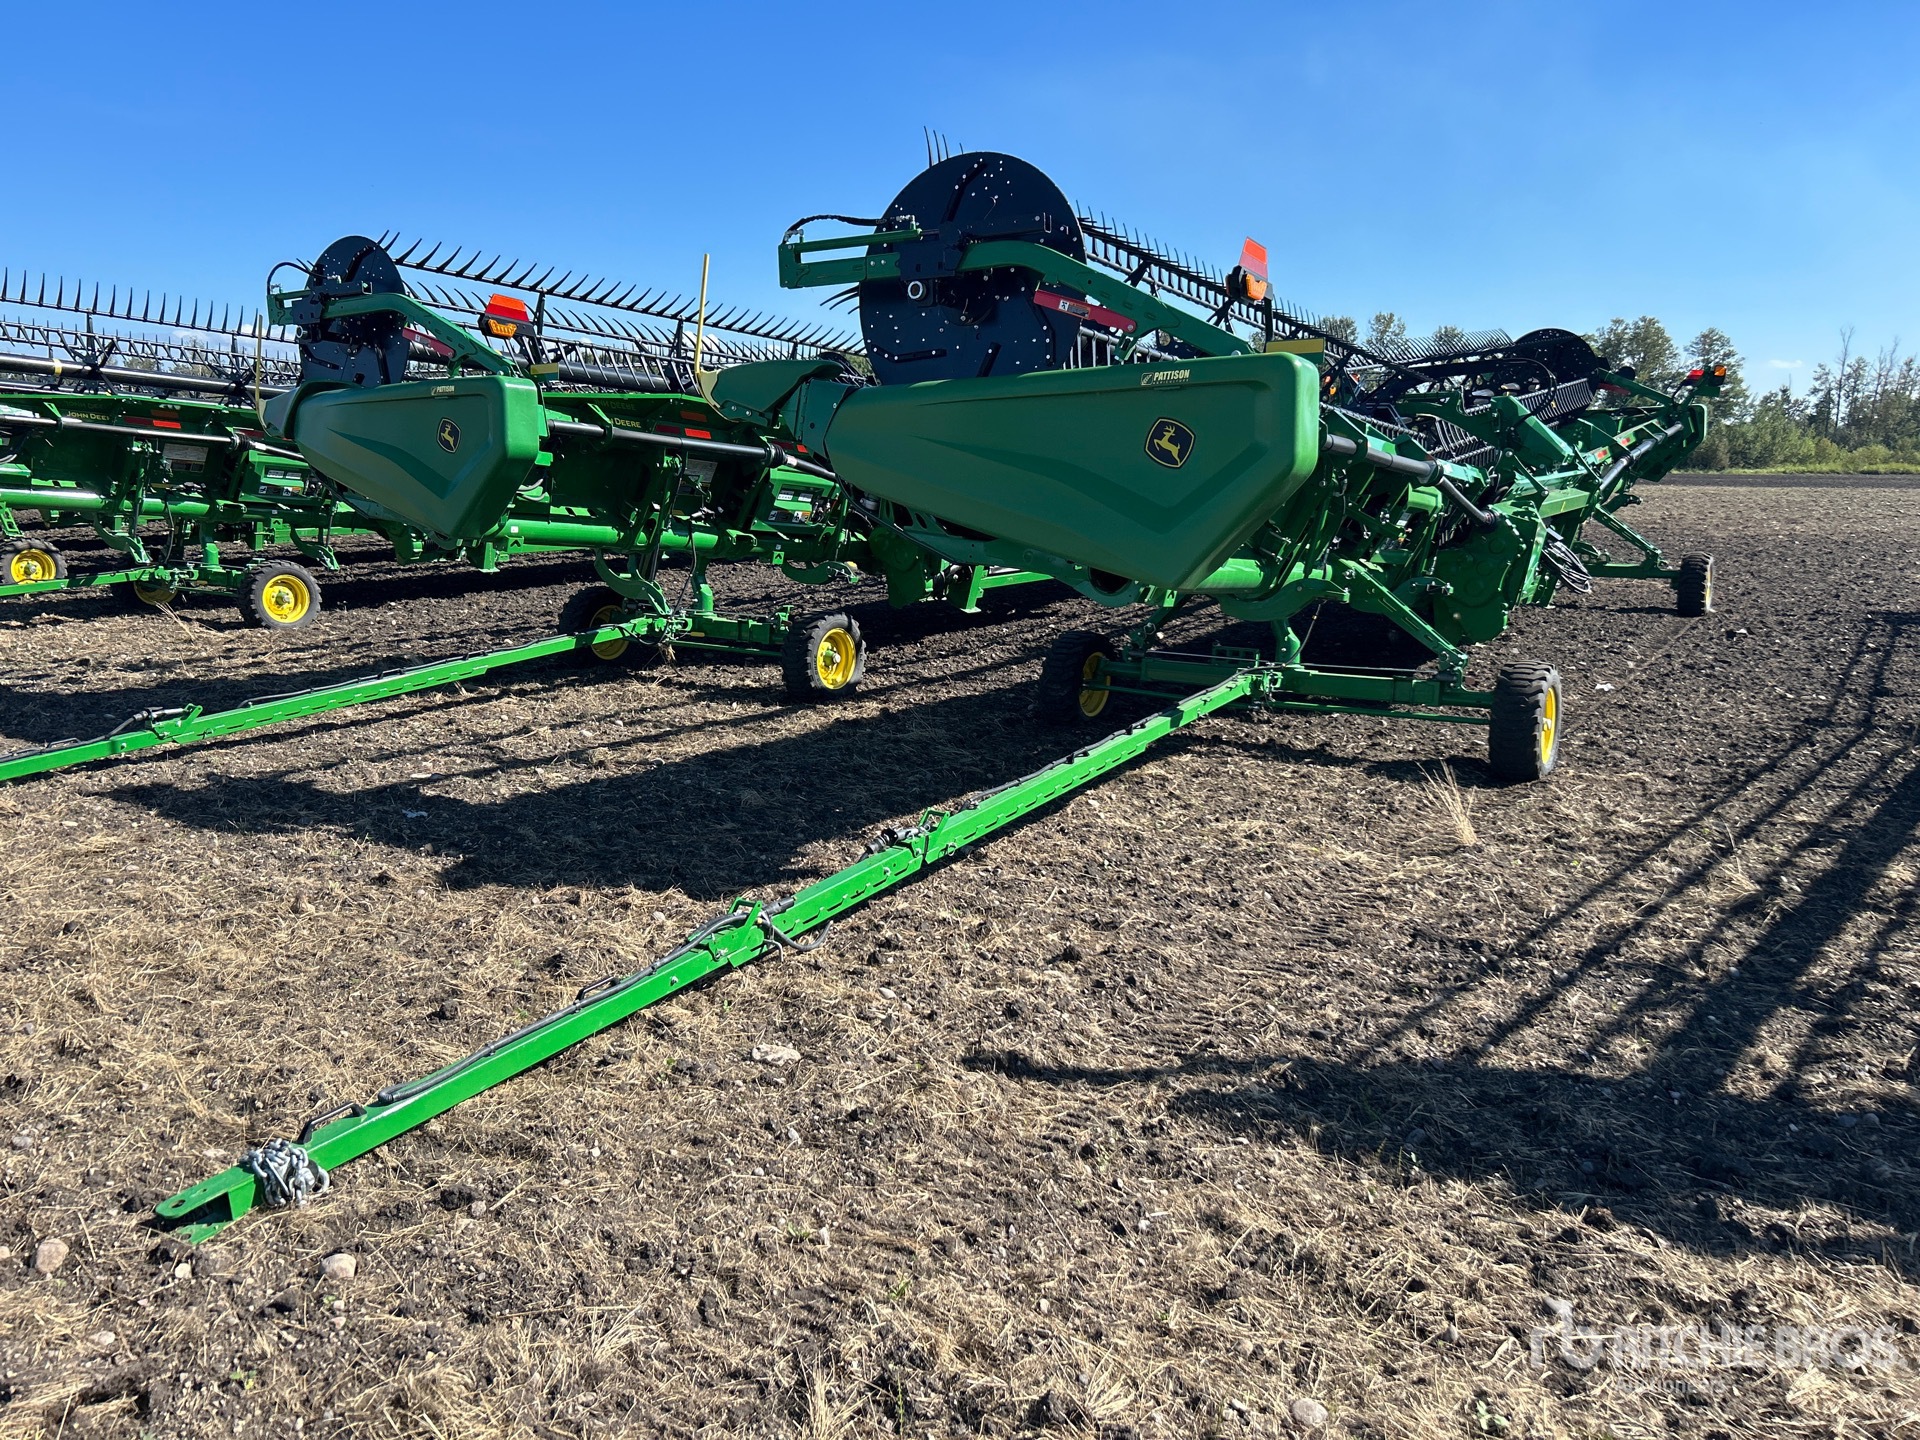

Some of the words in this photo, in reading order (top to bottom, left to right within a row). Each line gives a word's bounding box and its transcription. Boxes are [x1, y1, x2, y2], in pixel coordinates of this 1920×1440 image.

[1153, 369, 1190, 381] PATTISON
[66, 410, 89, 419] JOHN
[614, 417, 642, 428] DEERE
